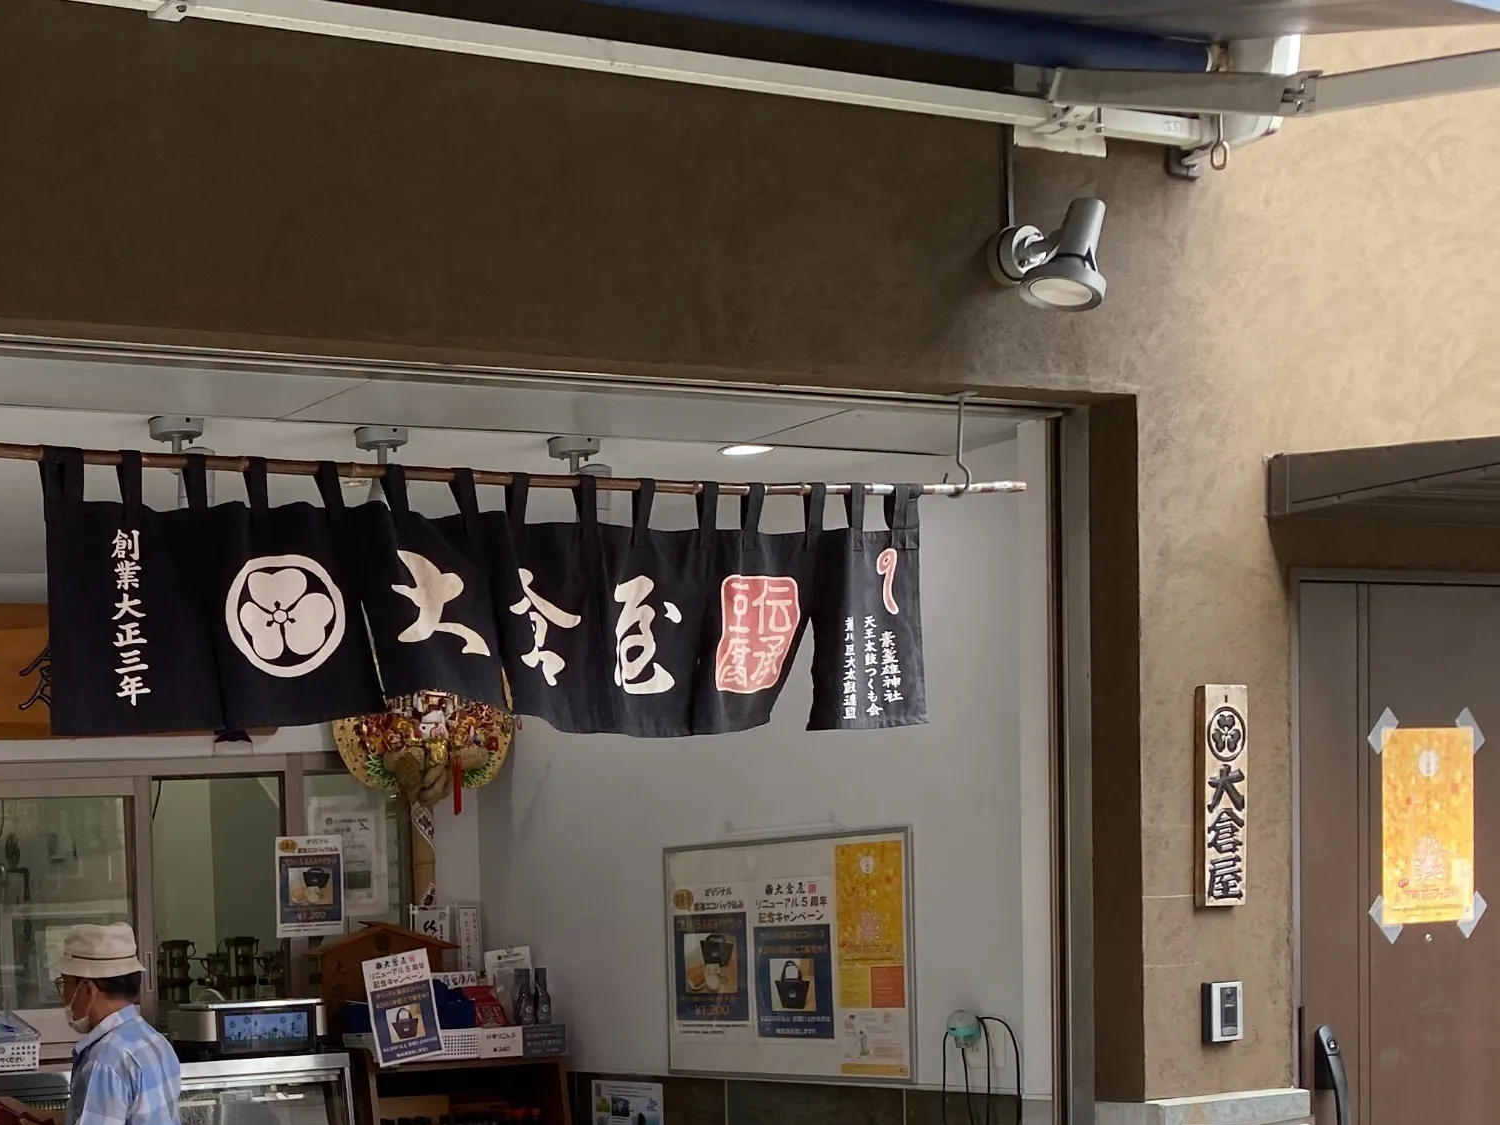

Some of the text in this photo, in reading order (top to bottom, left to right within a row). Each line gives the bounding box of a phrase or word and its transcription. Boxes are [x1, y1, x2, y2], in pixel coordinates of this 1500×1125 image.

[111, 529, 151, 706] 創業大正三年
[391, 549, 682, 694] 大倉屋
[1207, 763, 1245, 901] 大倉屋
